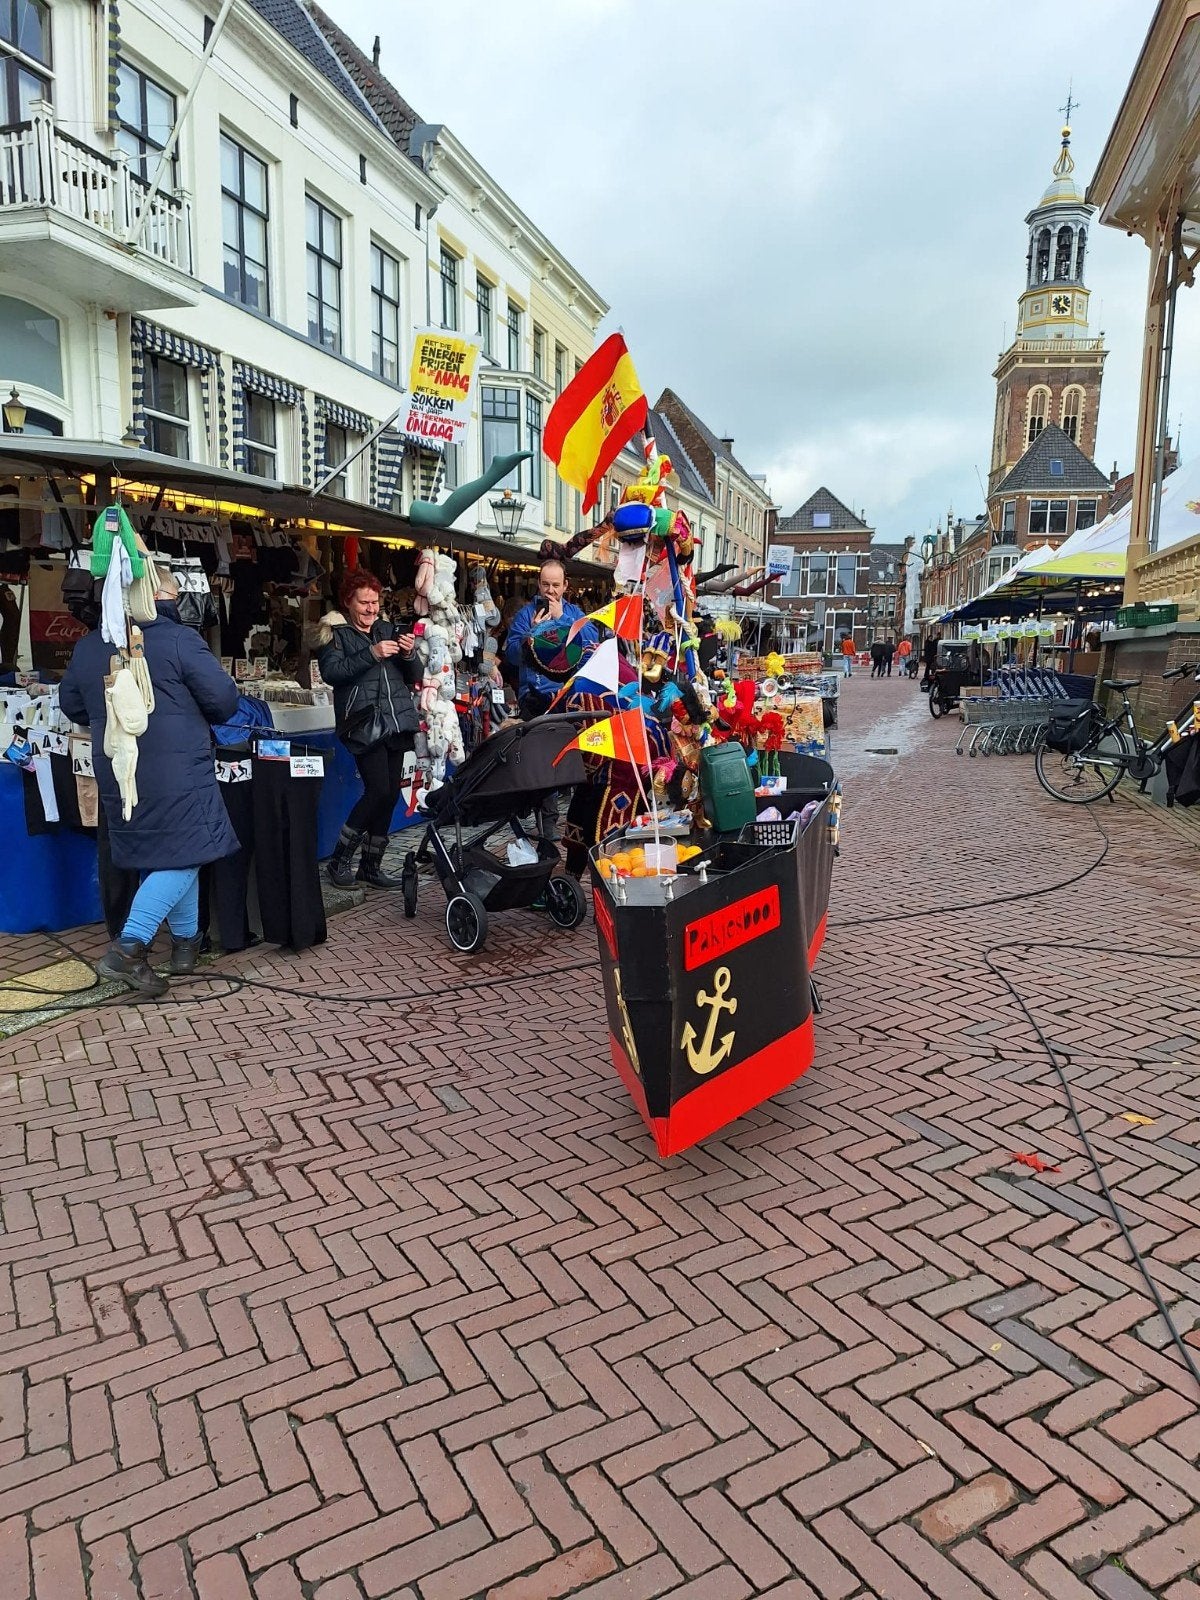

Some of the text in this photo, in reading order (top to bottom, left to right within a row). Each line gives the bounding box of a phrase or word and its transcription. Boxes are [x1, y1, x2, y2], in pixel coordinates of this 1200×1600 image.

[424, 339, 452, 350] MET DIE
[421, 346, 466, 364] ENERGIE
[420, 356, 461, 374] PRIJZEN
[418, 366, 426, 374] IN
[434, 370, 470, 393] MAAG
[416, 385, 440, 396] MET DE
[411, 391, 454, 411] SOKKEN
[406, 416, 454, 442] OMLAAG
[45, 615, 89, 637] Euro
